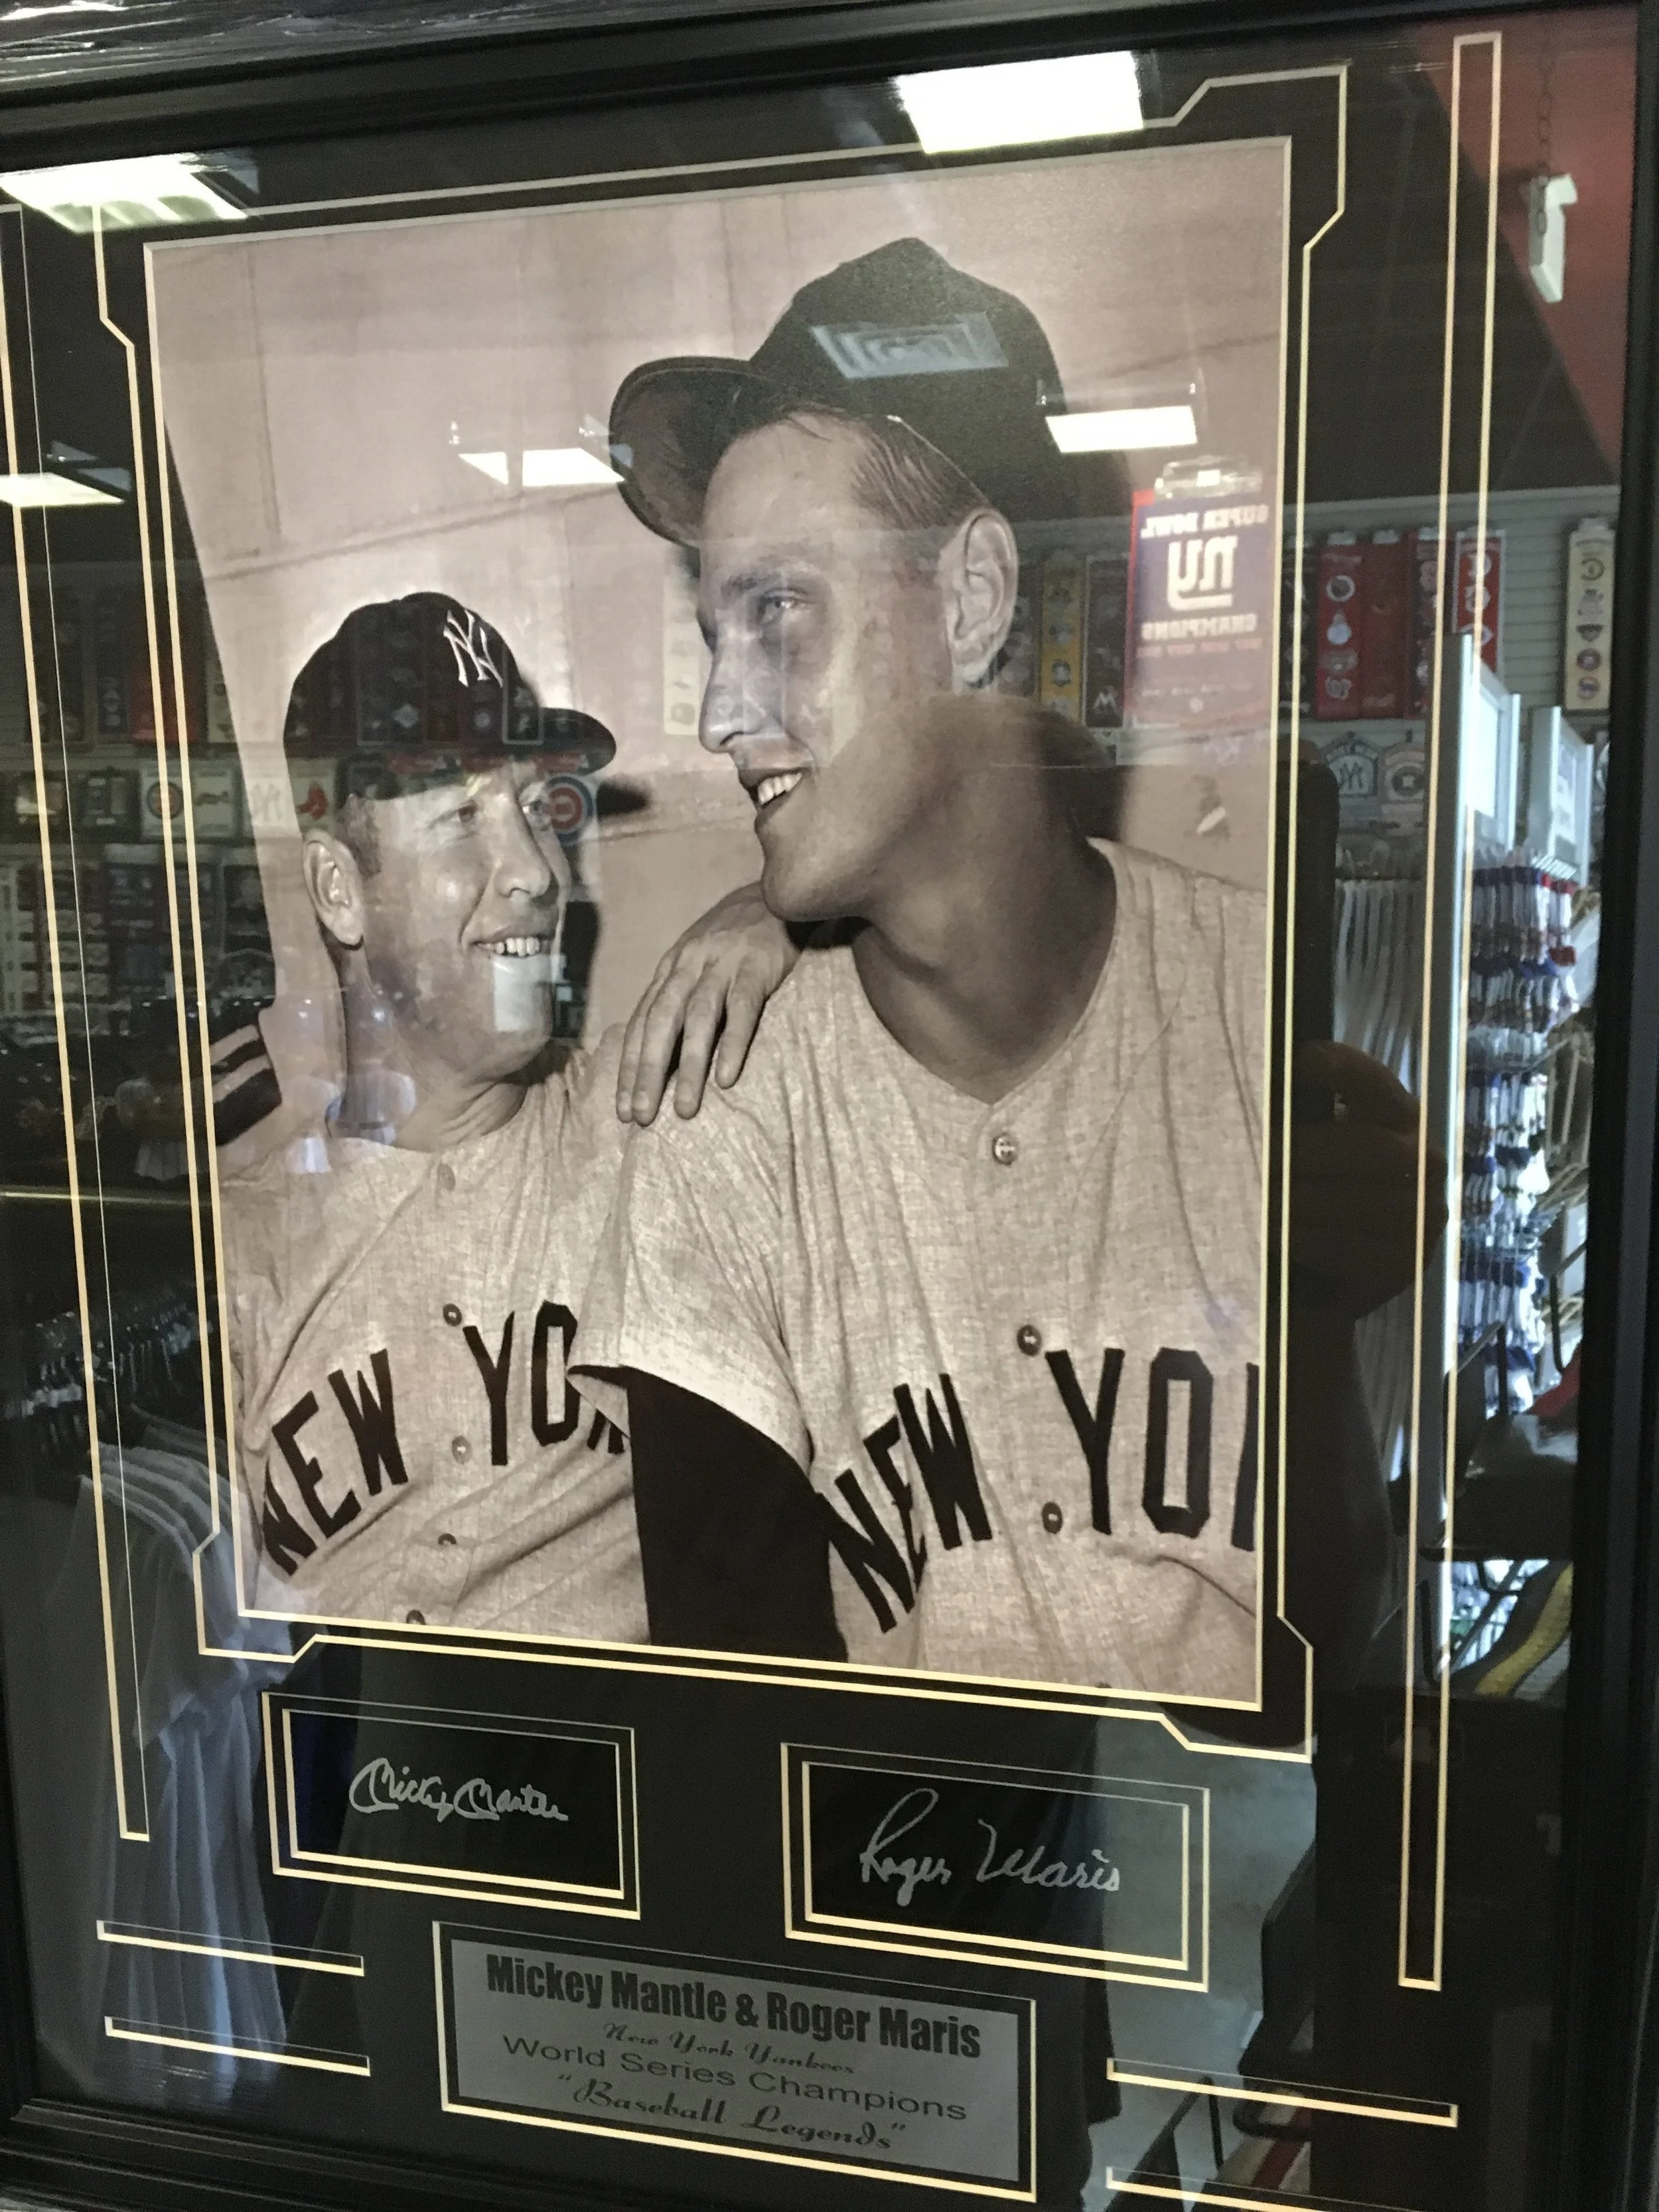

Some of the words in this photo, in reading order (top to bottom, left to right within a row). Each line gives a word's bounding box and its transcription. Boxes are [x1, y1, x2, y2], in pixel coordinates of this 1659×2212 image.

[443, 607, 503, 688] NY
[263, 1348, 409, 1577] NEW
[811, 1372, 993, 1633] NEW
[486, 1953, 604, 2010] Mickey
[611, 1970, 727, 2023] Mantle
[735, 1993, 759, 2028] &
[766, 1991, 871, 2043] Roger
[879, 2006, 981, 2058] Maris
[603, 2022, 660, 2046] New
[669, 2030, 734, 2057] York
[745, 2042, 855, 2074] Yankees
[502, 2033, 606, 2068] World
[620, 2052, 737, 2087] Series
[749, 2071, 967, 2120] Champions
